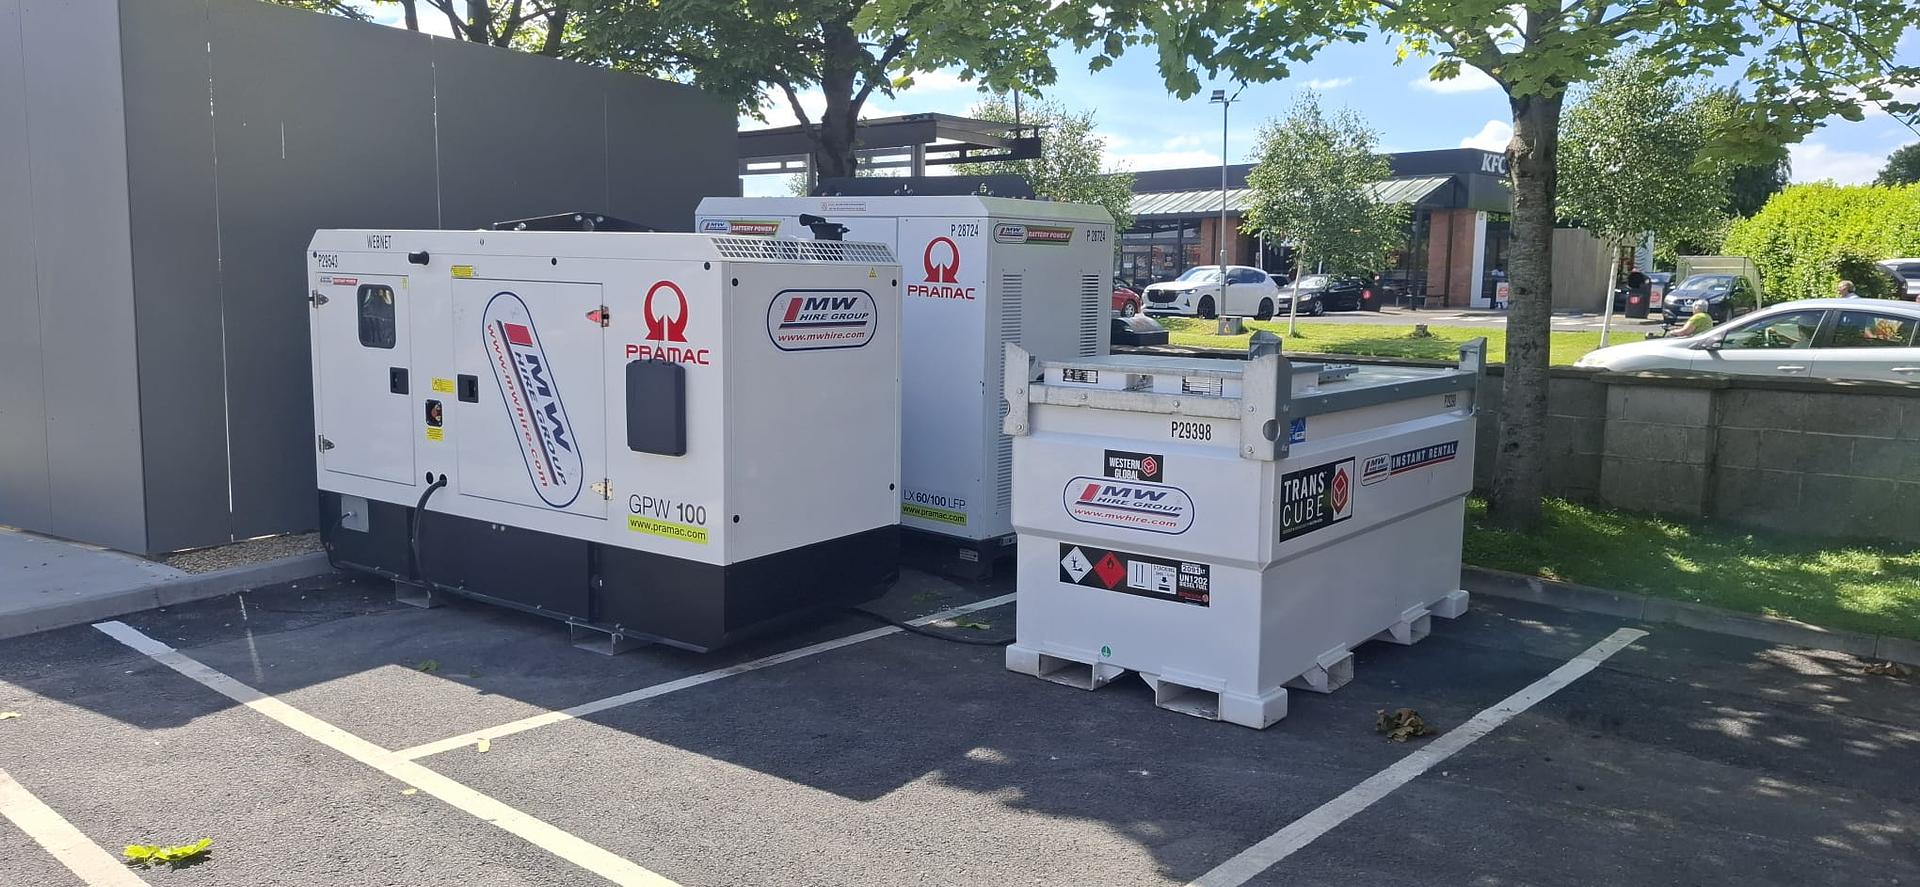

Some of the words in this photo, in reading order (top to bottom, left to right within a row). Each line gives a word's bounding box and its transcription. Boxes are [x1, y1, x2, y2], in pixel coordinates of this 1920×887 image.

[1481, 152, 1506, 174] KFC
[951, 224, 956, 236] P
[958, 224, 979, 237] 28724
[1086, 230, 1091, 241] P
[1092, 230, 1106, 242] 28724
[367, 235, 391, 249] WEBNET
[318, 254, 338, 268] P29543
[908, 284, 976, 300] PRAMAC
[804, 297, 858, 310] MW
[778, 332, 865, 341] www.mwhire.com
[626, 344, 709, 365] PRAMAC
[487, 324, 548, 487] www.mwhire.com
[524, 354, 571, 452] MW
[515, 351, 537, 402] HIRE
[537, 409, 567, 486] GROUP
[1171, 421, 1212, 441] P29398
[1109, 457, 1140, 469] WESTERN
[1371, 456, 1386, 466] MW
[1393, 451, 1426, 468] INSTANT
[1429, 444, 1455, 459] RENTAL
[1114, 469, 1139, 480] GLOBAL
[1102, 486, 1168, 501] MW
[1284, 472, 1324, 503] TRANS
[904, 489, 914, 500] LX
[916, 492, 946, 506] 60/100
[949, 498, 966, 509] LFP
[1097, 497, 1130, 506] HIRE
[1133, 501, 1183, 512] GROUP
[629, 494, 670, 518] GPW
[676, 503, 706, 525] 100
[903, 505, 965, 523] www.pramac.com
[1074, 508, 1177, 527] www.mwhire.com
[1283, 495, 1324, 527] CUBE
[630, 519, 706, 540] www.pramac.com
[1180, 574, 1208, 586] UN1202
